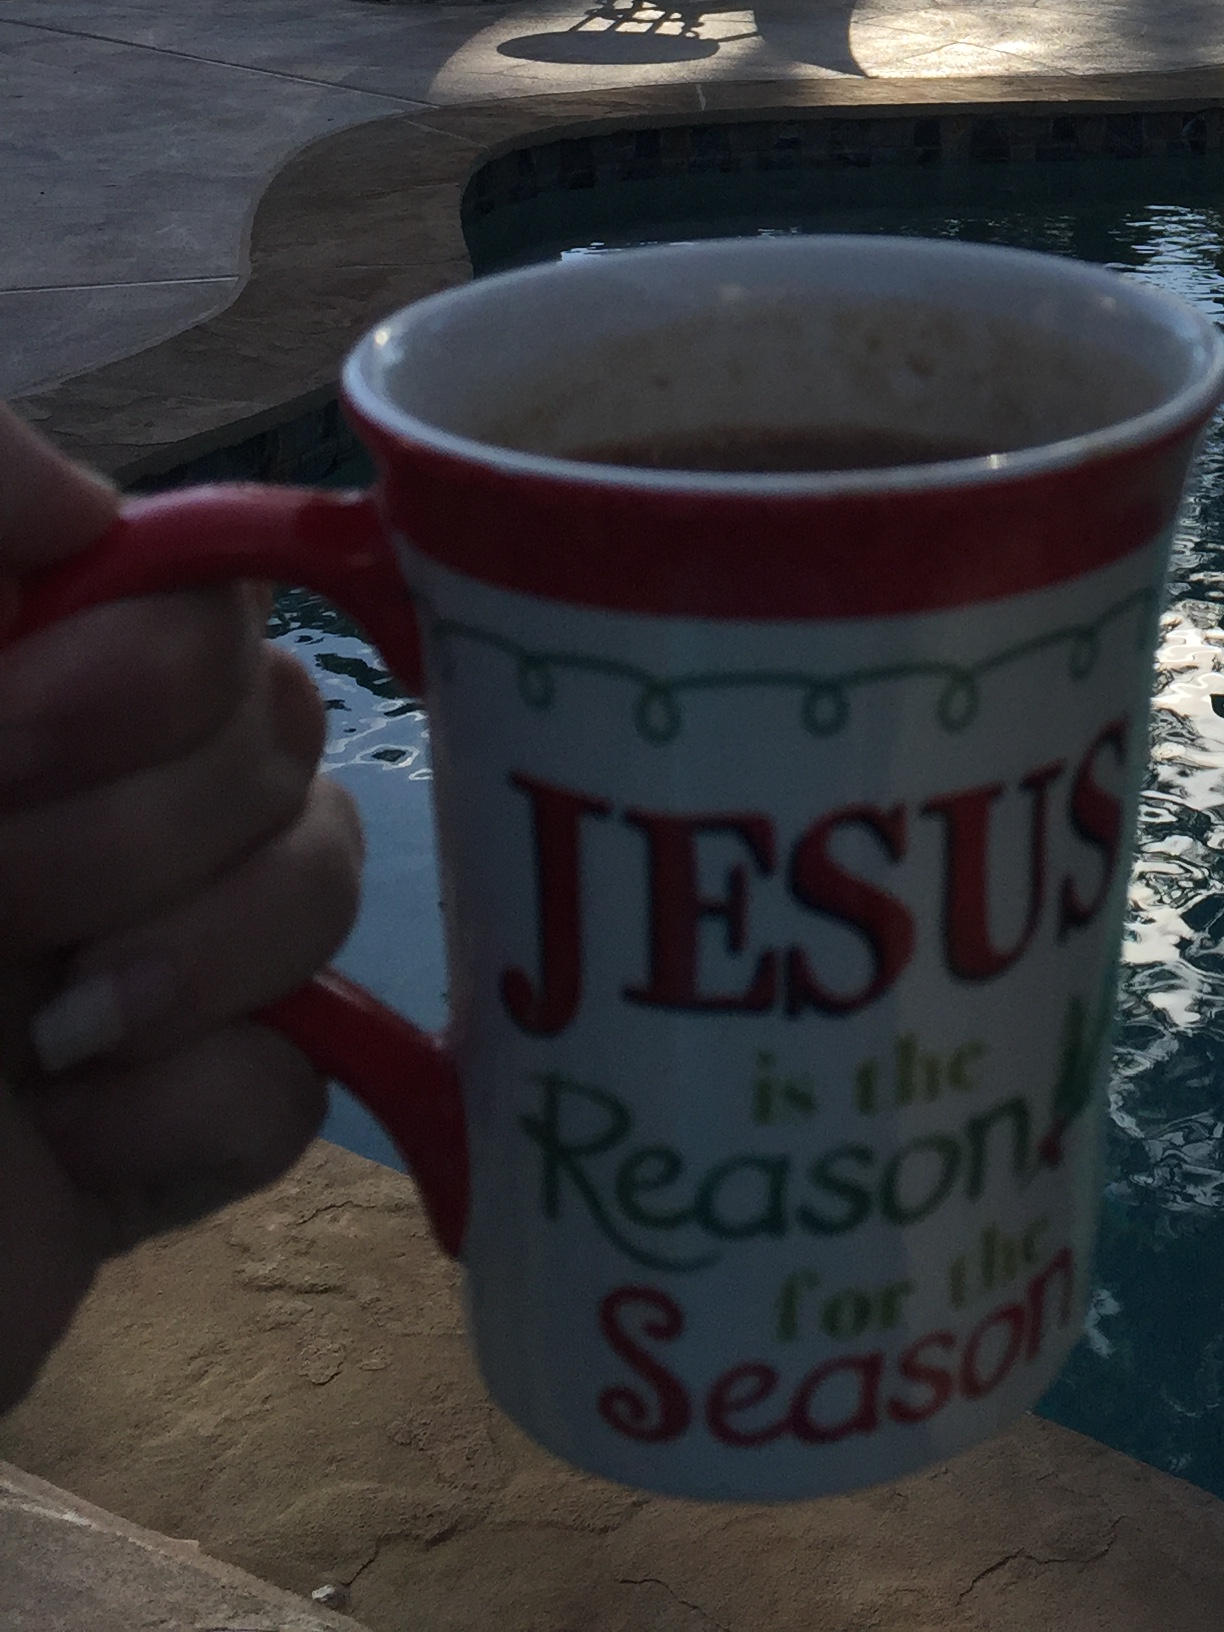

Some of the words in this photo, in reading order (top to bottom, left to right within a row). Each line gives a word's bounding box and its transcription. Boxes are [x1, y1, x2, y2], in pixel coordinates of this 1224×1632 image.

[500, 718, 1128, 1036] JESUS
[520, 1073, 1030, 1271] Reason
[753, 1052, 814, 1125] is
[856, 1033, 984, 1114] the
[600, 1248, 1074, 1448] Season
[773, 1273, 912, 1342] for
[949, 1217, 1048, 1308] the
